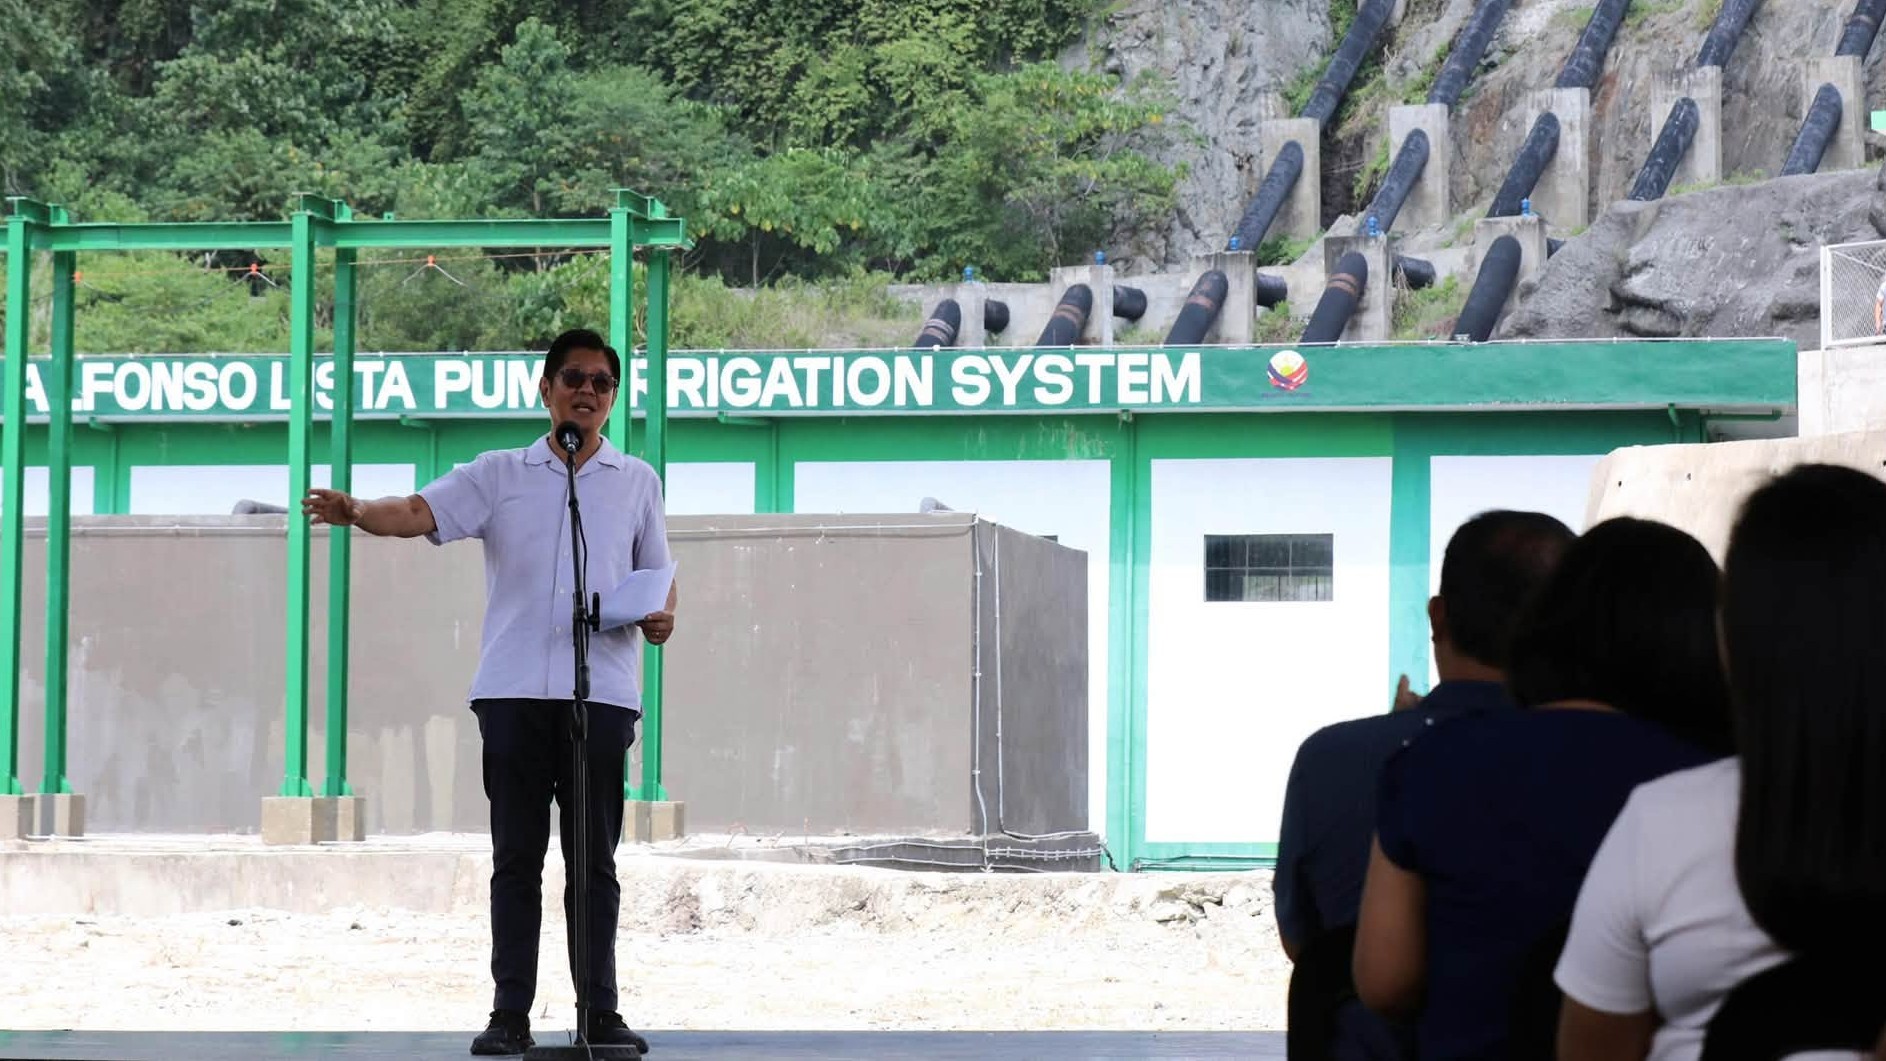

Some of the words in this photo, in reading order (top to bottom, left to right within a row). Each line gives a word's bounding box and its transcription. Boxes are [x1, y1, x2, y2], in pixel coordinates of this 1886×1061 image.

[434, 359, 547, 409] PUM
[630, 356, 934, 408] RIGATION
[950, 352, 1201, 406] SYSTEM
